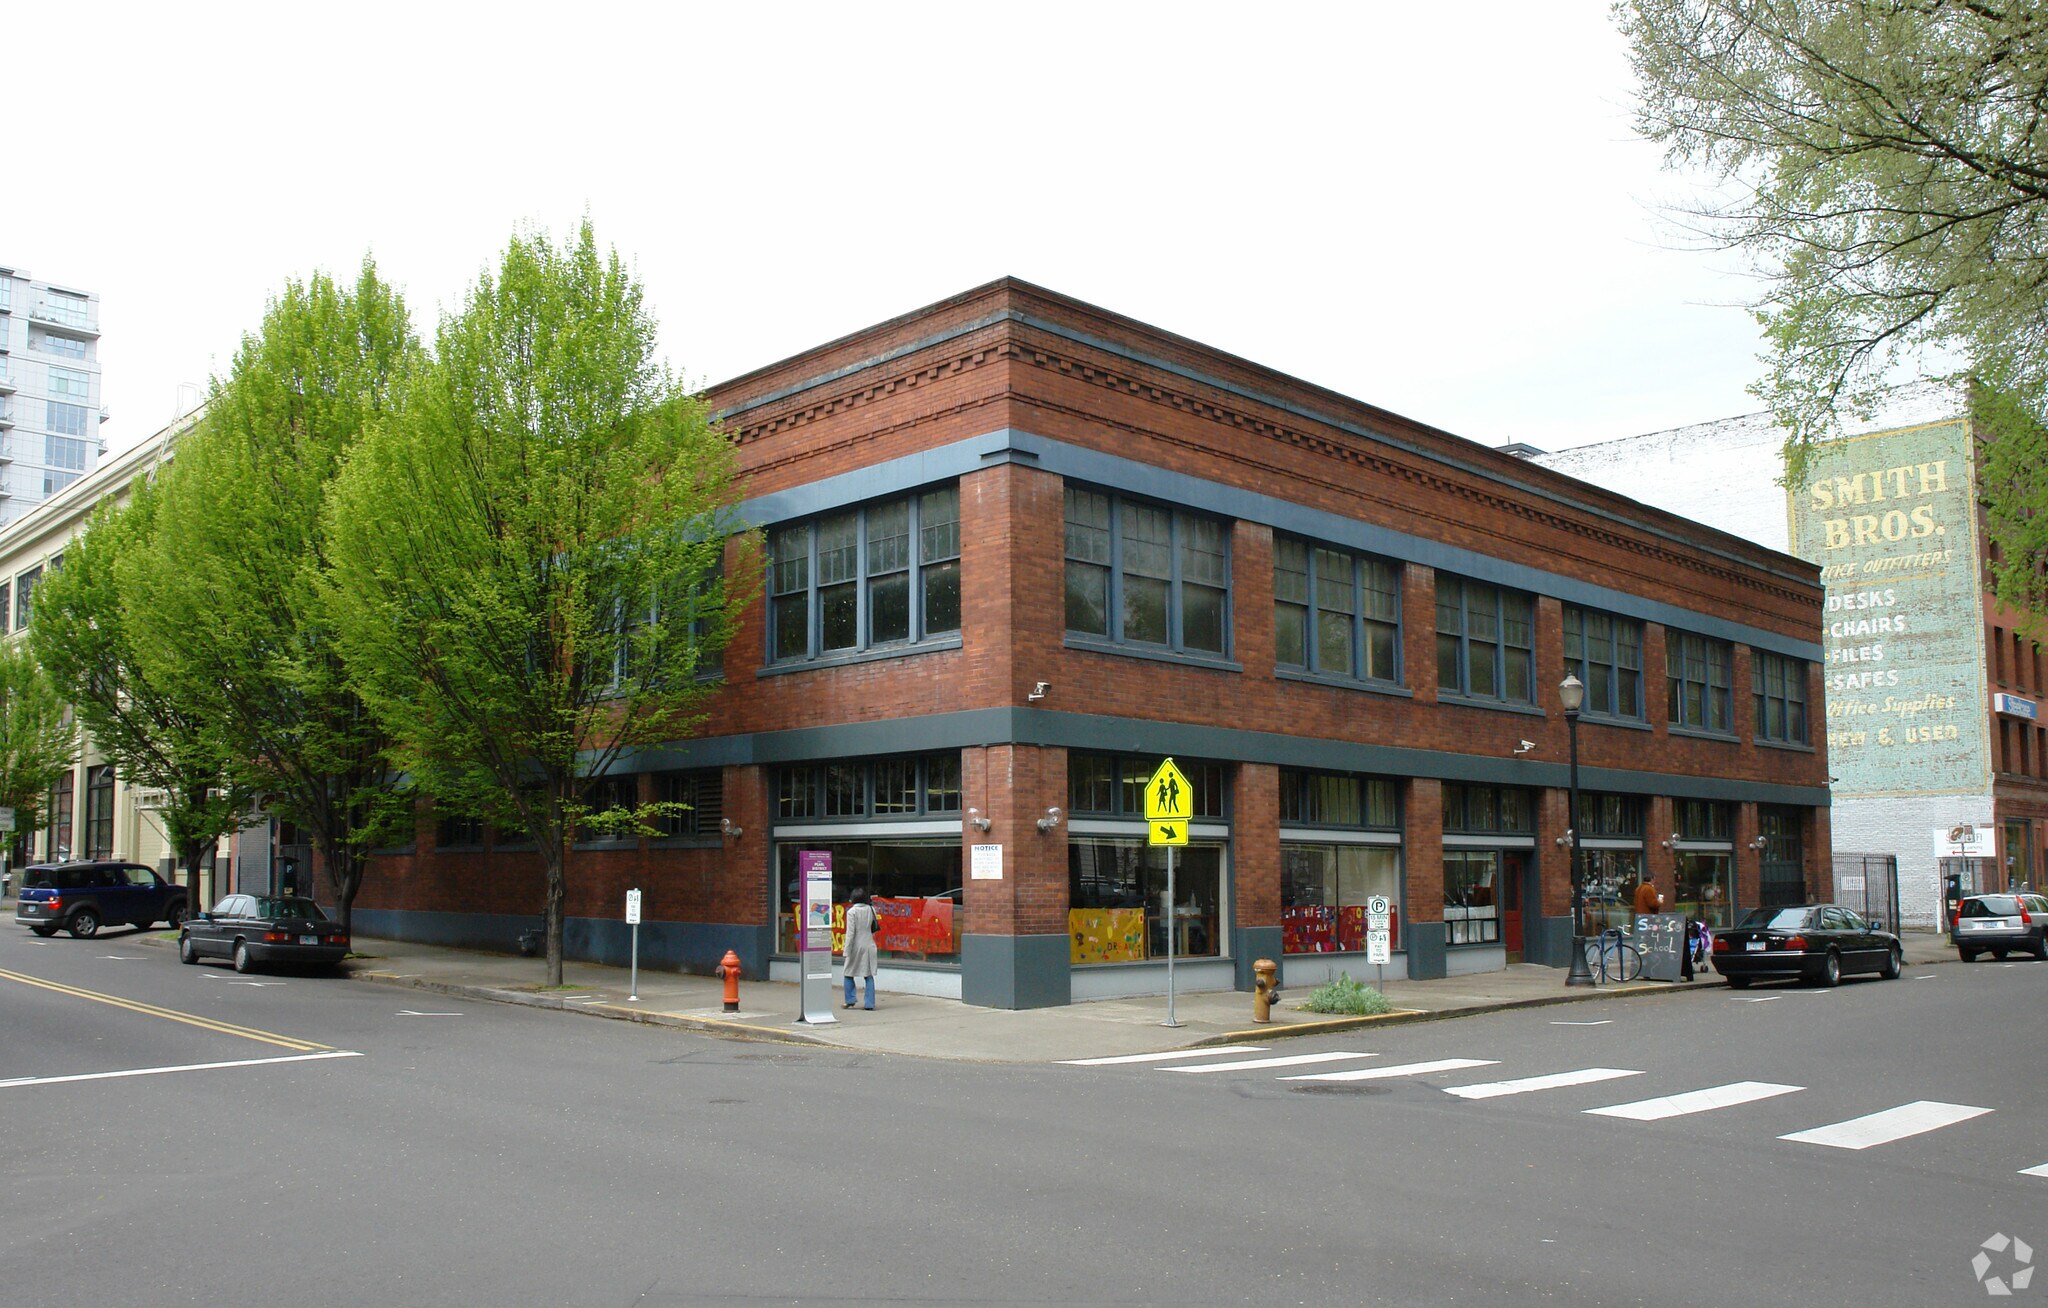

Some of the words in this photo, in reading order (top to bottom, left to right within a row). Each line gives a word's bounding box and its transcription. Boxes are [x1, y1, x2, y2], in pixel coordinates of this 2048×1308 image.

[1811, 461, 1949, 511] SMITH
[1822, 503, 1946, 550] BROS.
[1863, 549, 1953, 573] OUTFITTERS
[1828, 588, 1896, 612] DESKS
[1830, 614, 1906, 638] CHAIRS
[1831, 644, 1884, 664] FILES
[1833, 669, 1900, 691] SAFES
[1881, 693, 1956, 718] Supplies
[1905, 724, 1958, 744] USED
